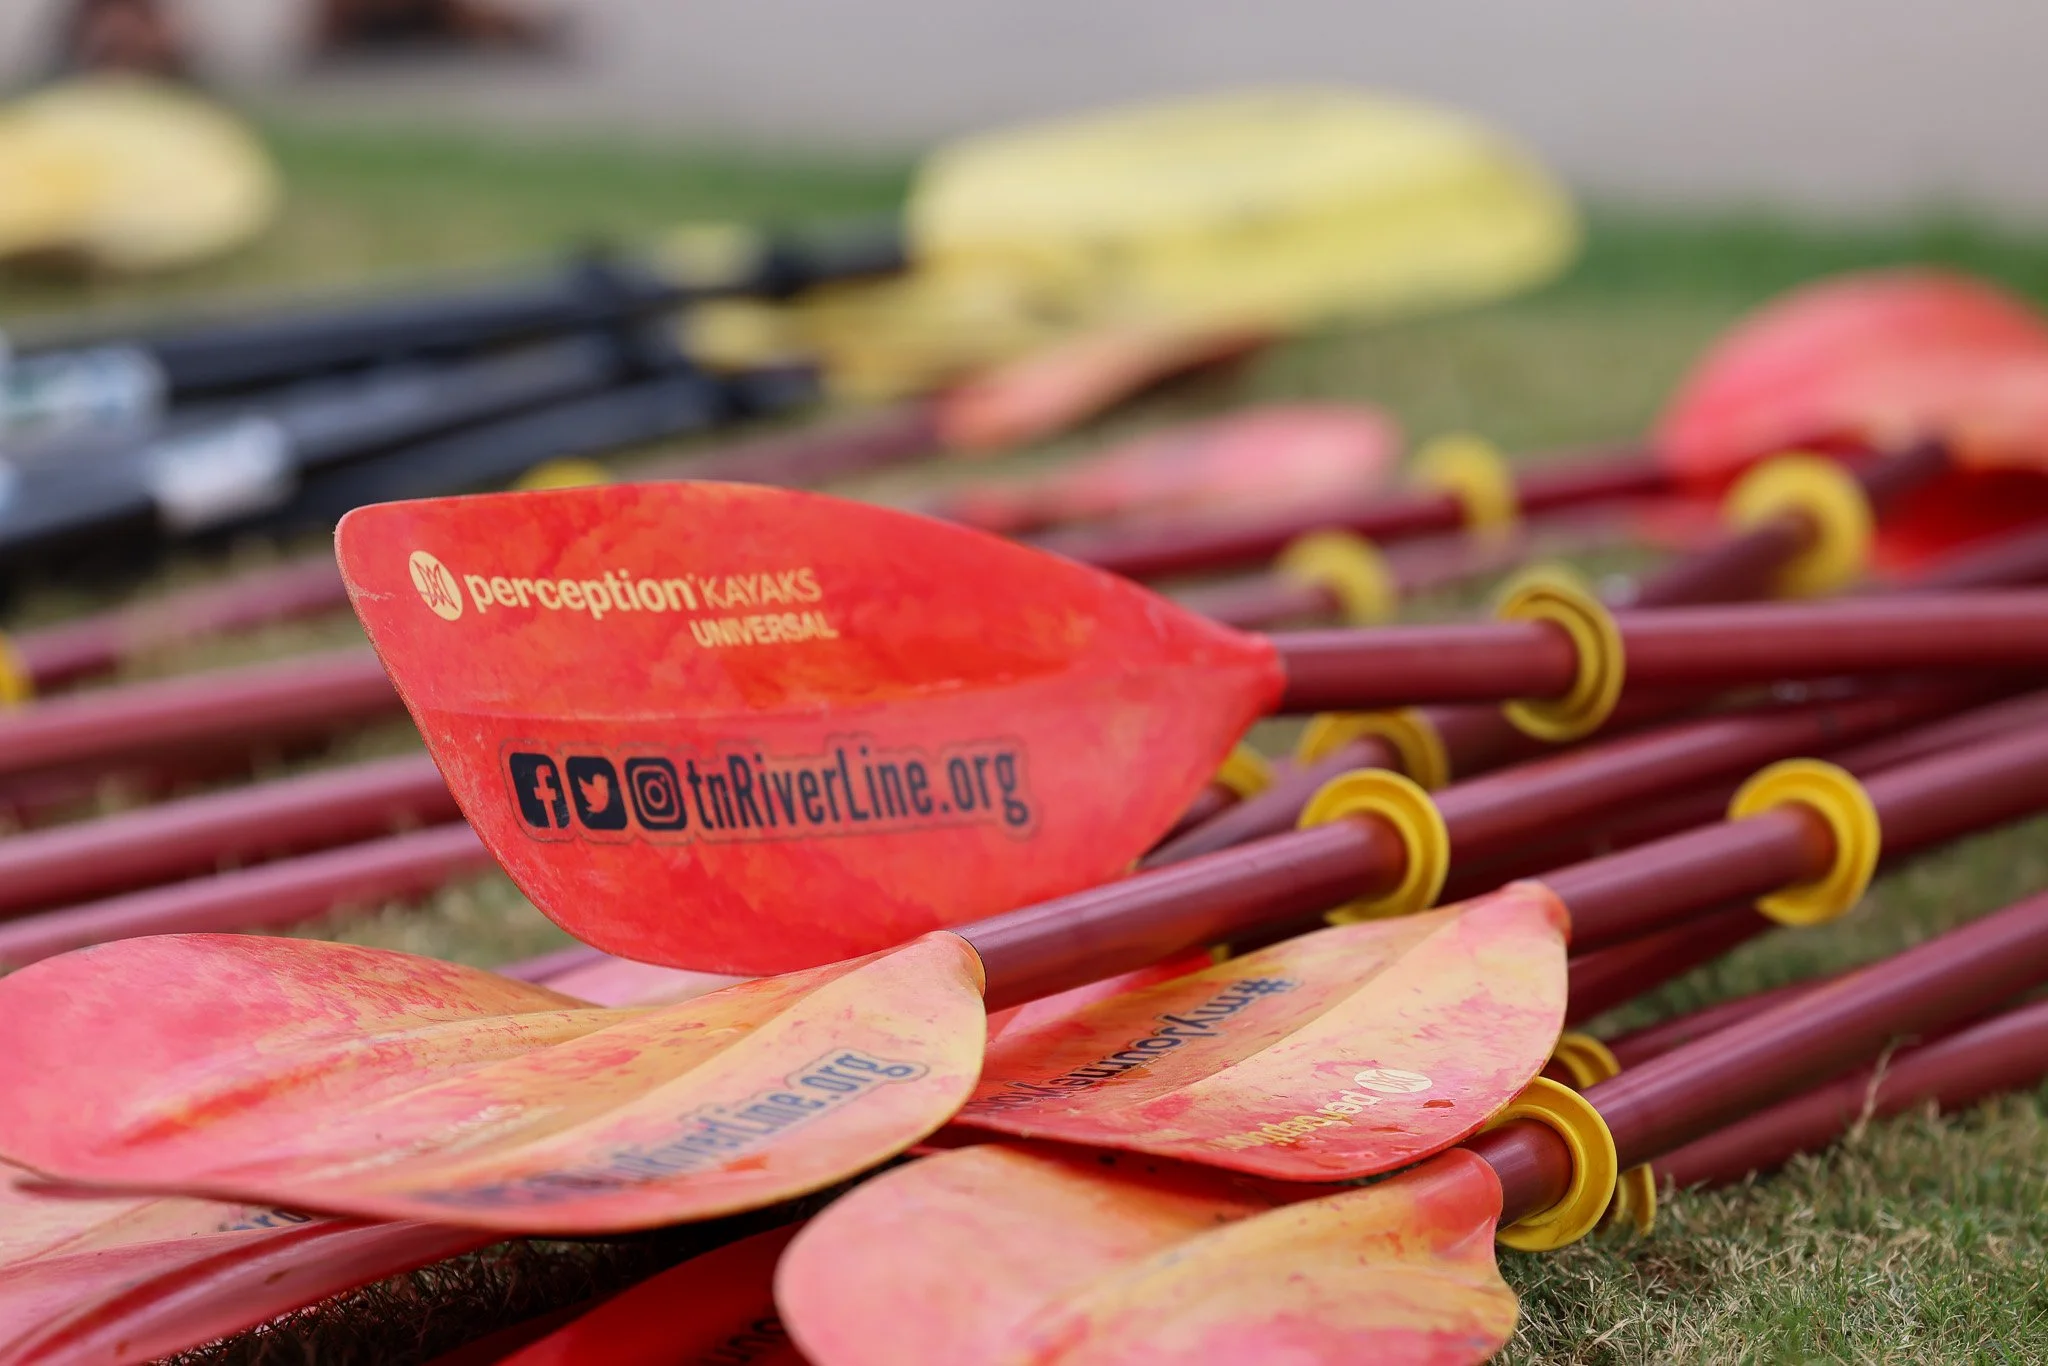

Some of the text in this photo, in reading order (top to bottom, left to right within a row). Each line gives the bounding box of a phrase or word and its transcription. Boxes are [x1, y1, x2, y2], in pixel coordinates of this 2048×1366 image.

[464, 568, 821, 620] perception KAYAKS
[689, 611, 839, 648] UNIVERSAL
[687, 748, 1030, 829] tnRiverLine.org
